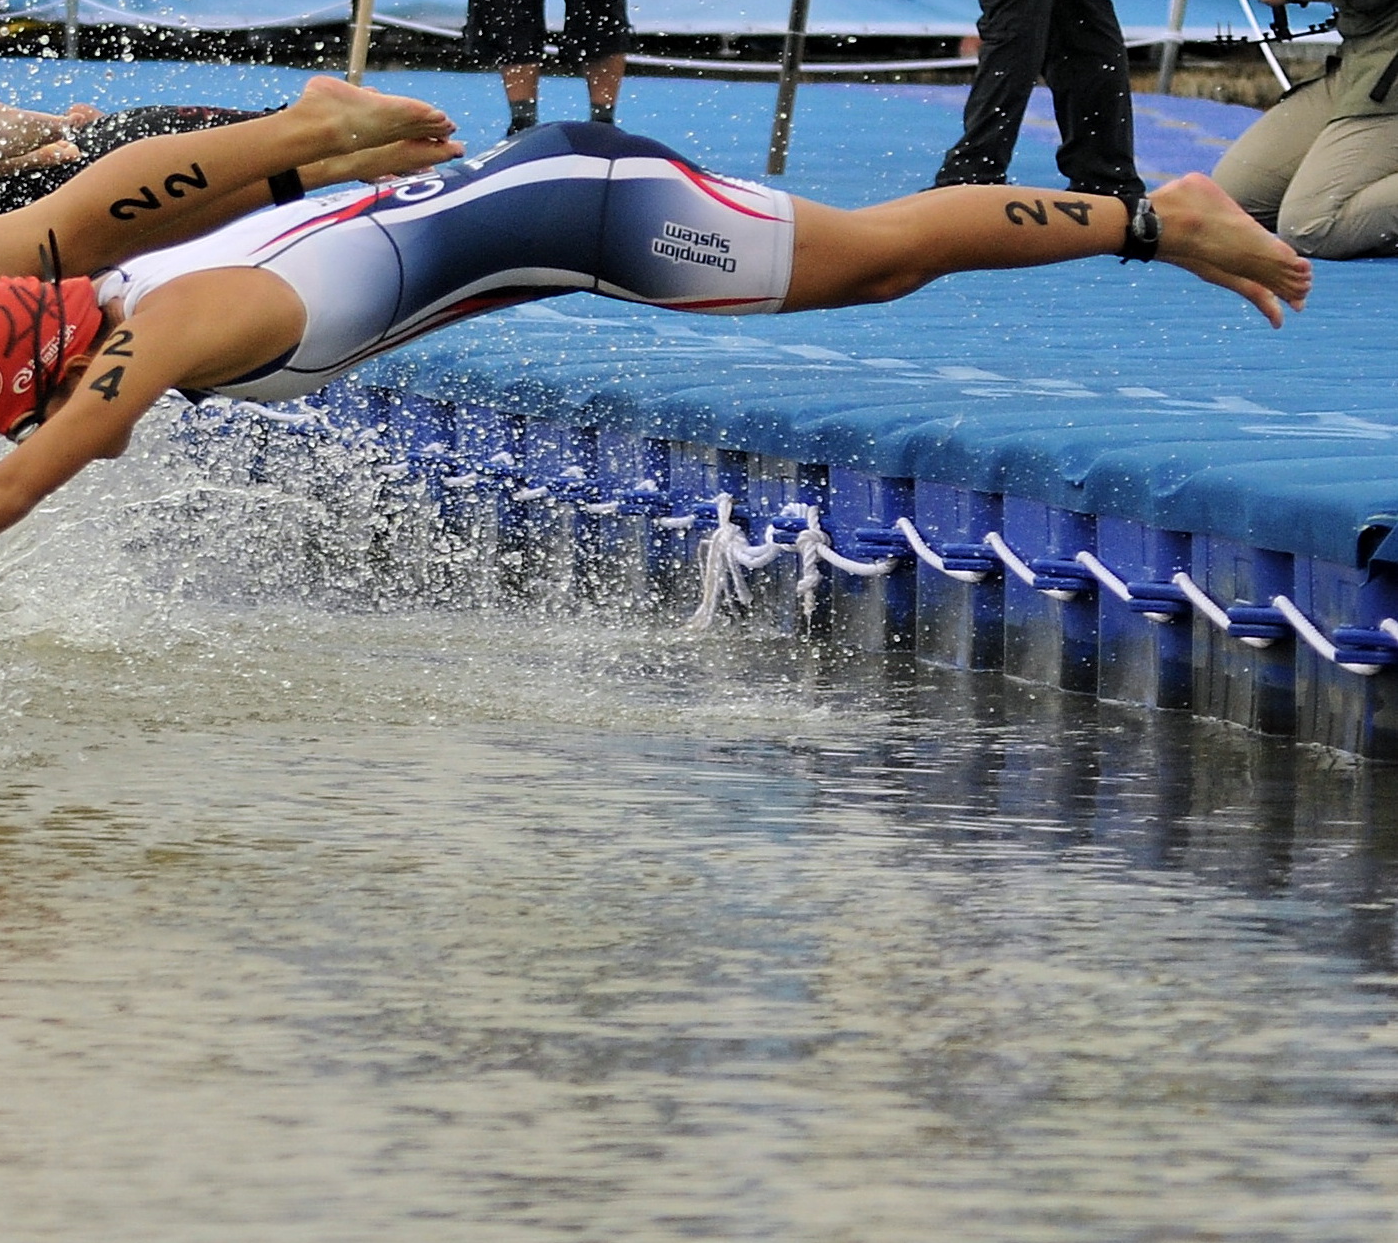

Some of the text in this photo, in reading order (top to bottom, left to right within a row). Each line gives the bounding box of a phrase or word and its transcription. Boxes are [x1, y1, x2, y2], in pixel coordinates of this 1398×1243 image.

[110, 162, 208, 220] 22
[1005, 199, 1093, 226] 24
[665, 224, 731, 253] System
[653, 240, 737, 273] Champion
